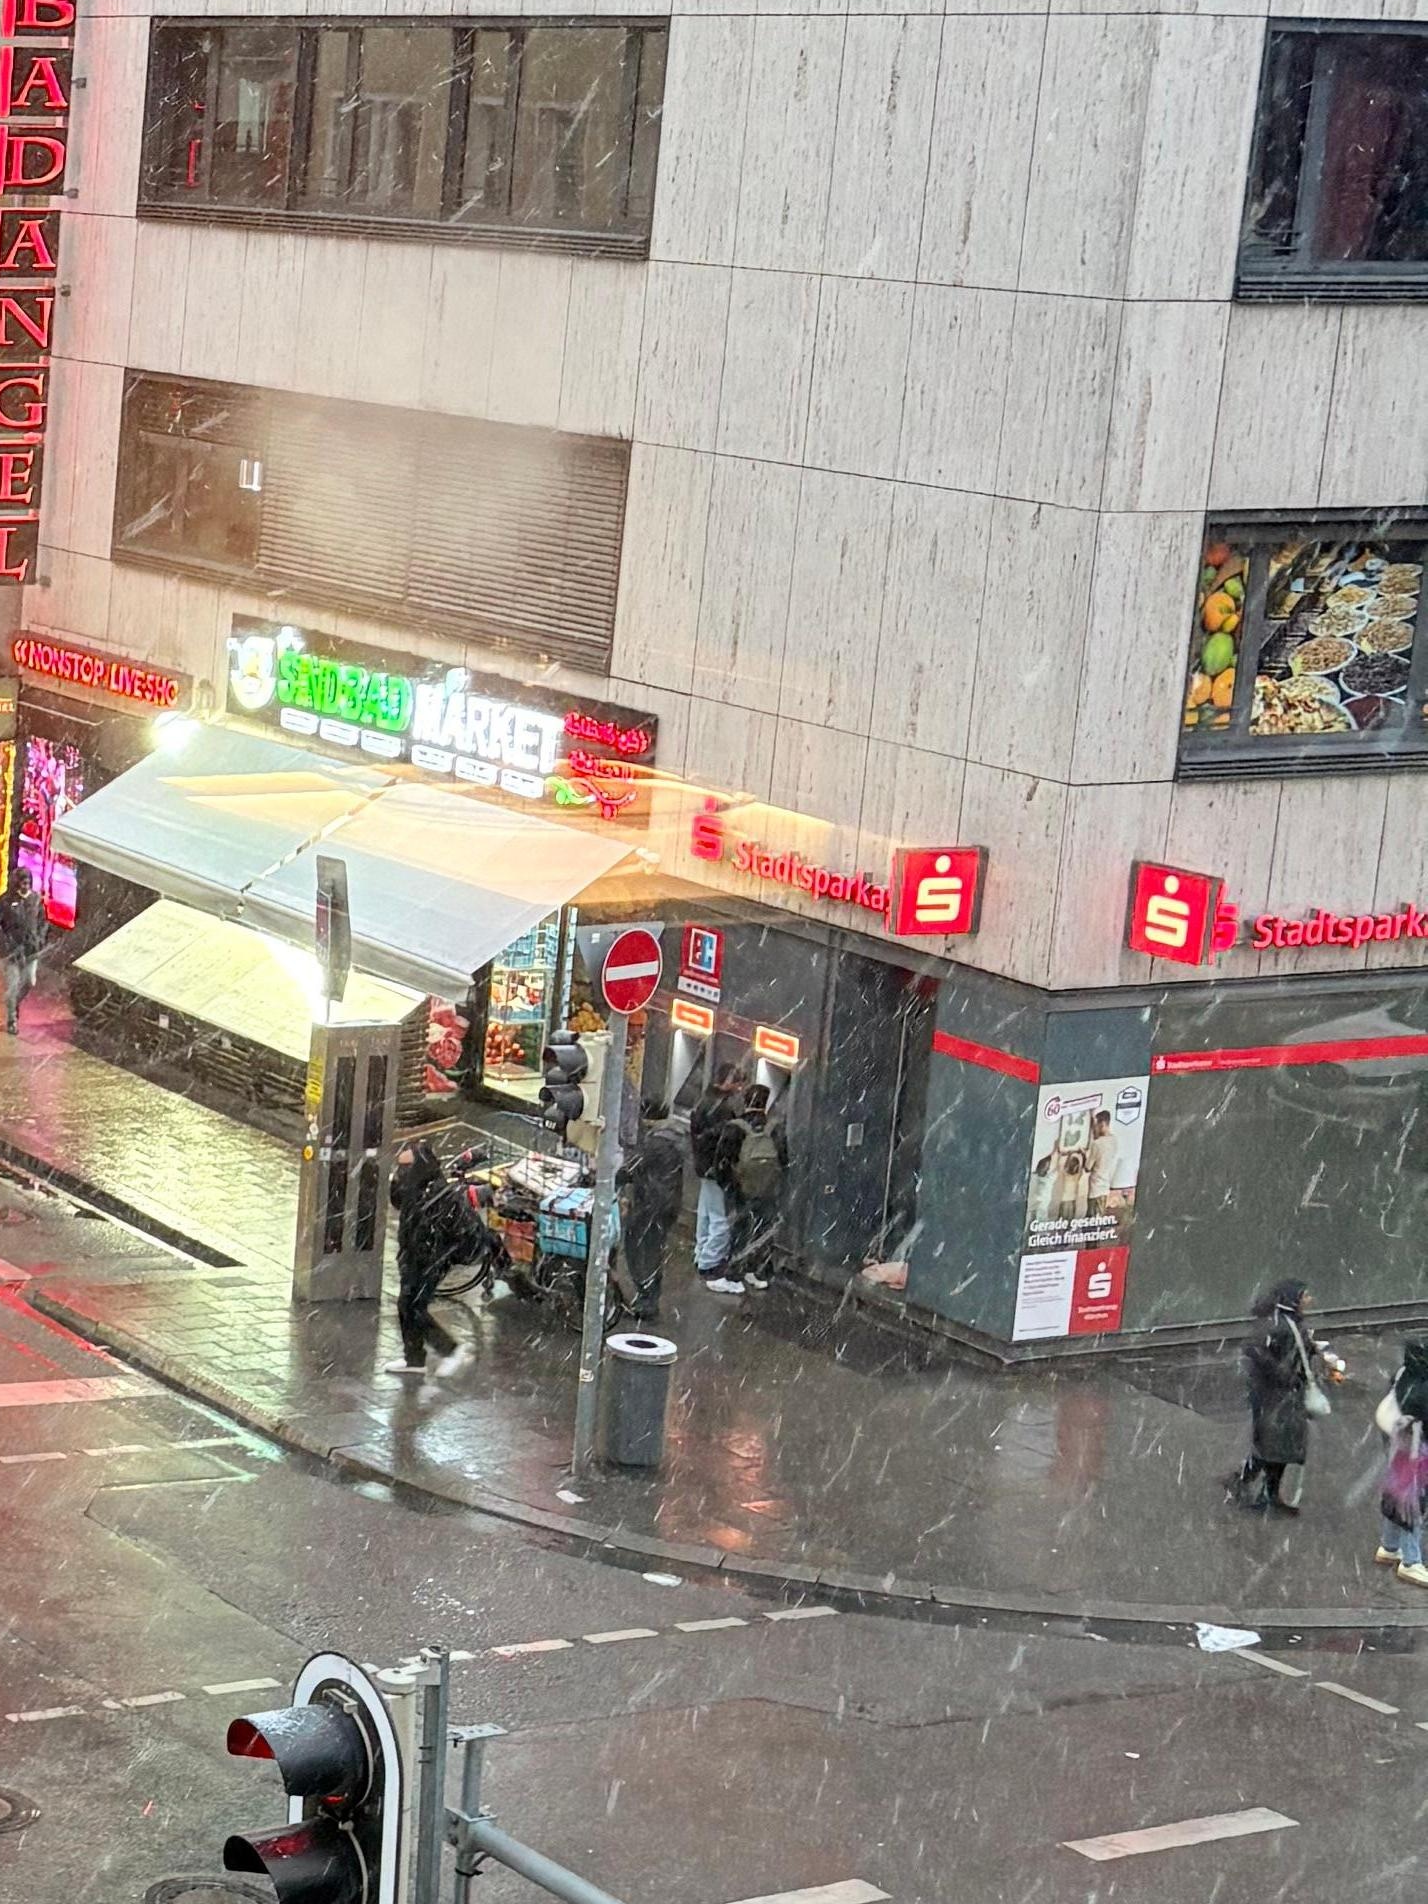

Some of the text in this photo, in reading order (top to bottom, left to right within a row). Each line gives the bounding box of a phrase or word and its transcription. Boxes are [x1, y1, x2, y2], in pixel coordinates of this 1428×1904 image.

[28, 639, 104, 687] NONSTOP
[276, 650, 413, 732] SINDBAD
[411, 682, 565, 775] MARKET
[1252, 902, 1428, 950] Stadtspark
[1027, 1227, 1119, 1248] Gleich finanziert.
[1029, 1213, 1119, 1233] Gerade gesehen.
